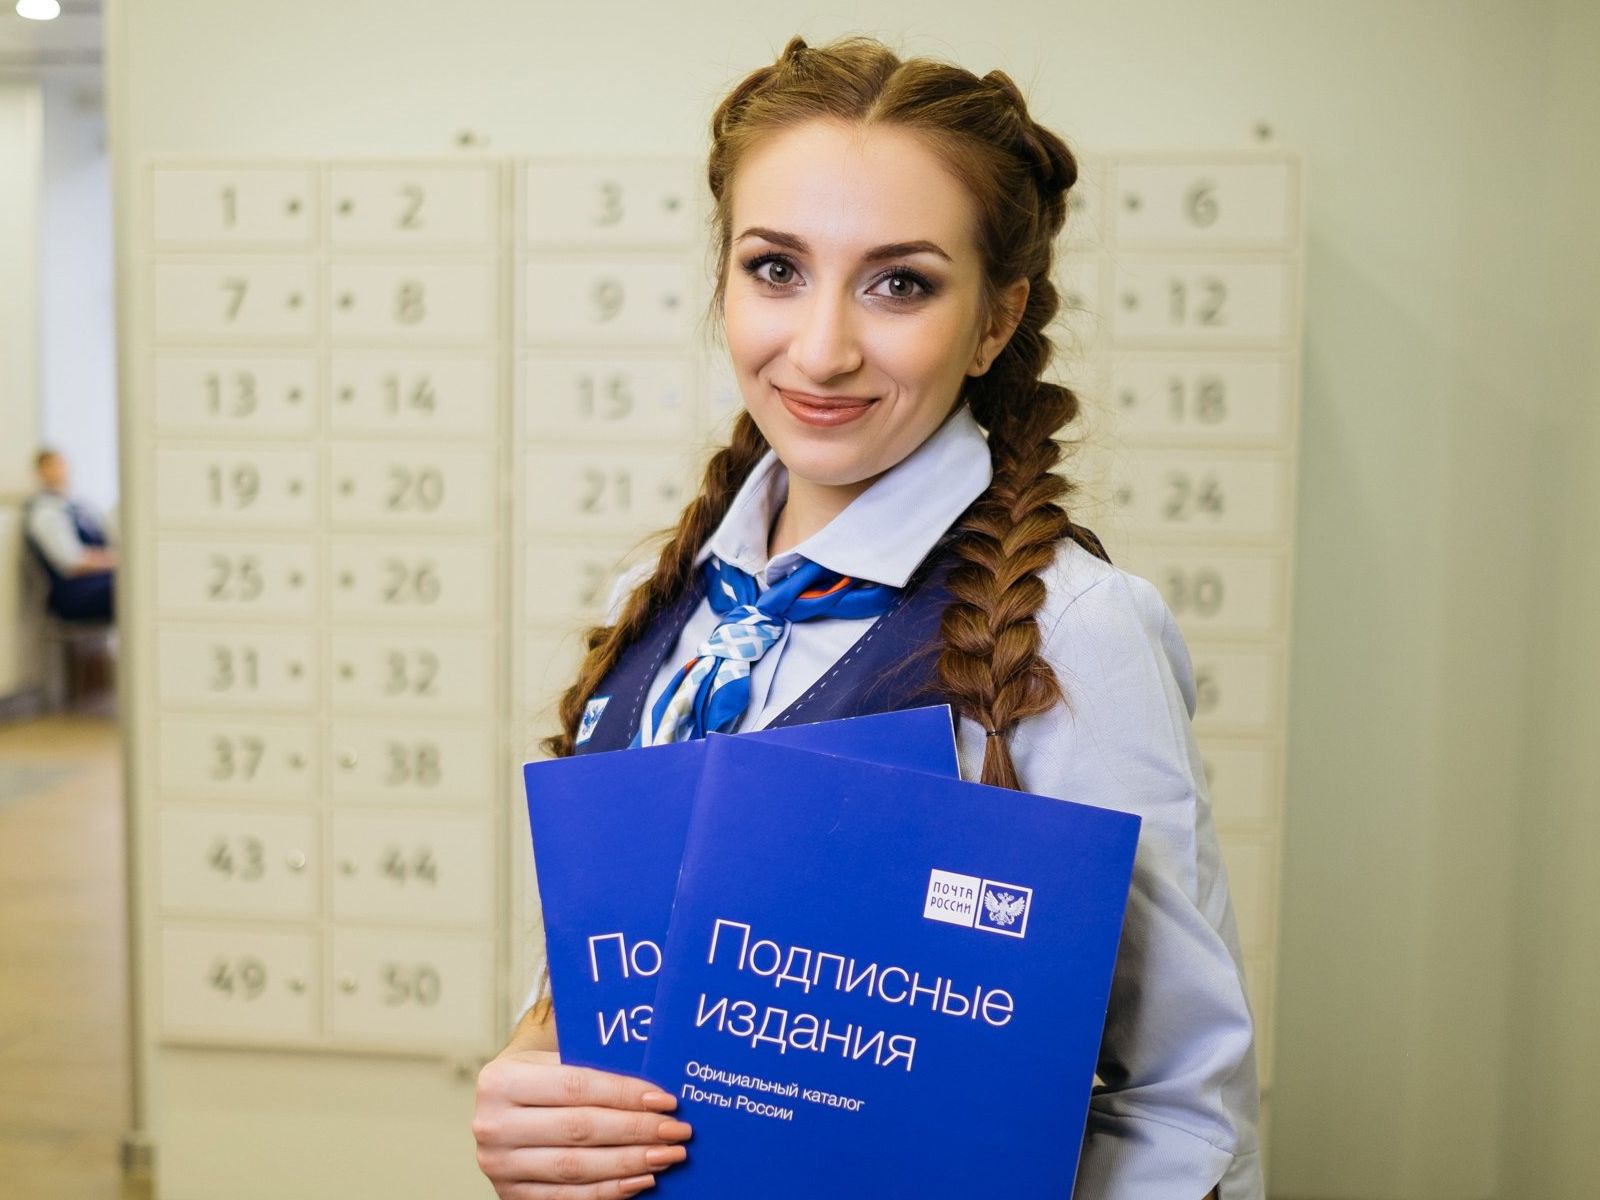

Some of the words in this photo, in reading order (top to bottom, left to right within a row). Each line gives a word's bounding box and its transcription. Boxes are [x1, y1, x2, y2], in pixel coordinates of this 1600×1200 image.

[218, 183, 238, 228] 1
[395, 183, 426, 231] 2
[594, 179, 625, 228] 3
[1182, 177, 1220, 229] 6
[221, 277, 249, 322] 7
[394, 280, 427, 326] 8
[589, 277, 625, 323] 9
[1168, 275, 1229, 328] 12
[203, 371, 259, 418] 13
[382, 373, 437, 417] 14
[574, 373, 635, 421] 15
[1168, 375, 1228, 425] 18
[205, 463, 261, 511] 19
[382, 465, 446, 513] 20
[576, 466, 632, 516] 21
[1162, 473, 1226, 522] 24
[205, 554, 265, 603] 25
[381, 558, 441, 605] 26
[209, 644, 260, 692] 31
[382, 648, 441, 698] 32
[210, 735, 266, 782] 37
[384, 740, 443, 788] 38
[206, 837, 266, 882] 43
[378, 847, 439, 889] 44
[930, 896, 971, 915] РОССИИ
[933, 881, 973, 900] ПОЧТА
[206, 957, 268, 1002] 49
[379, 961, 443, 1009] 50
[709, 919, 1014, 1027] Подписные
[696, 993, 917, 1072] издания
[682, 1084, 732, 1108] Почты
[735, 1095, 794, 1121] России
[686, 1061, 799, 1098] Официальный
[802, 1088, 865, 1112] каталог
